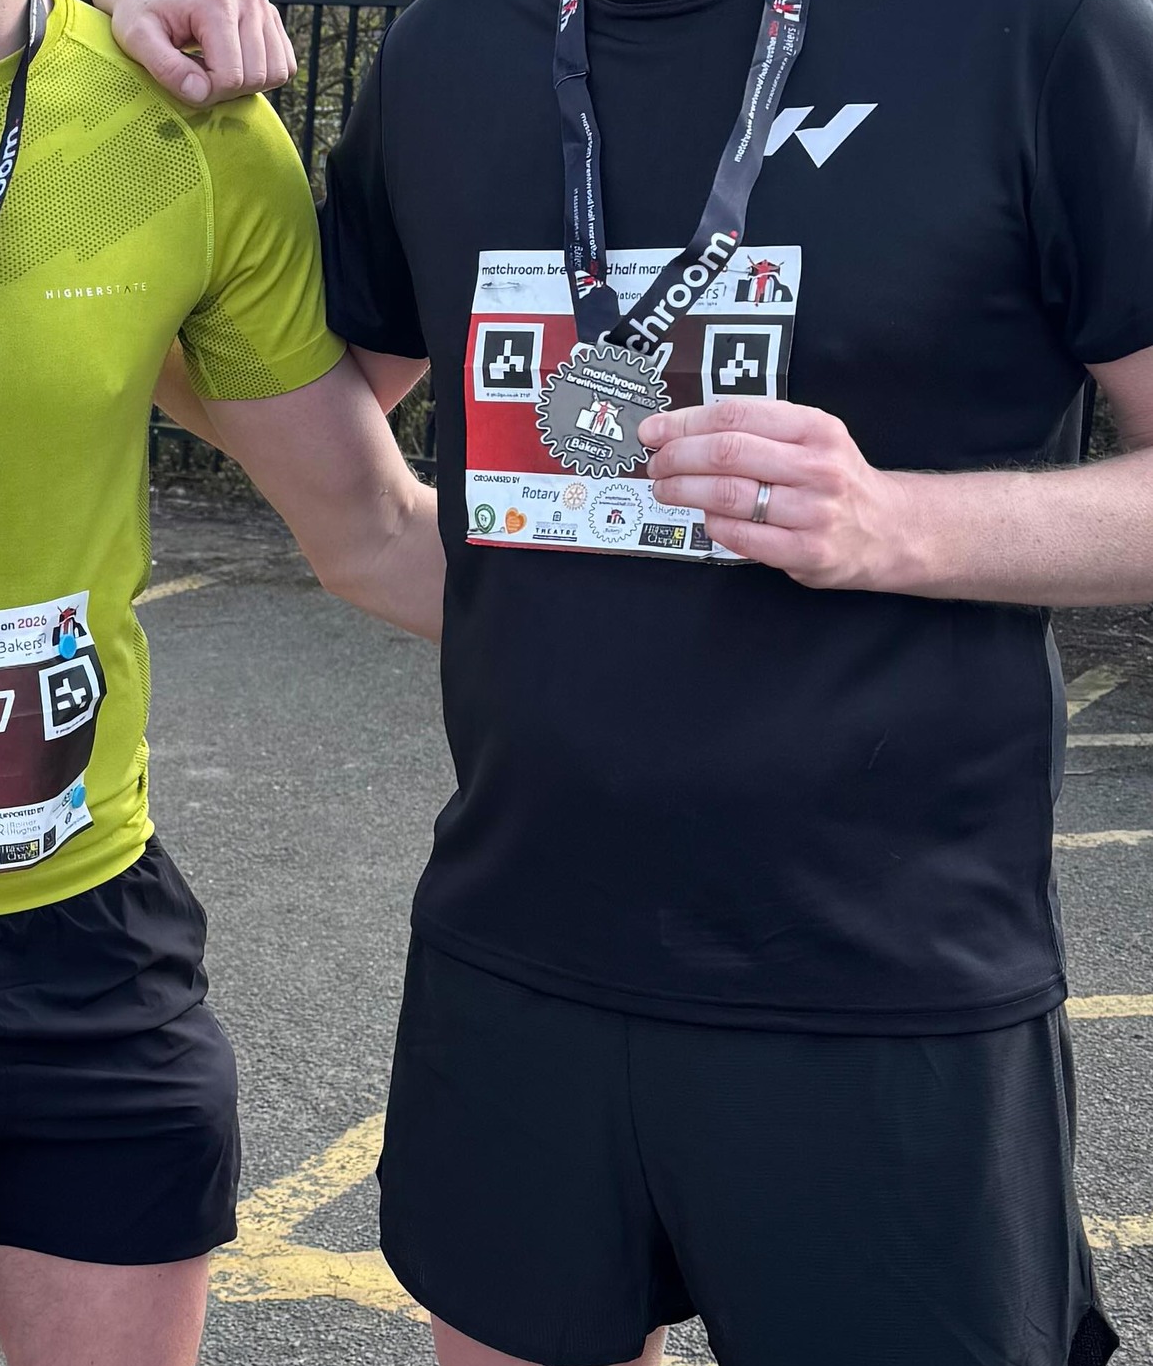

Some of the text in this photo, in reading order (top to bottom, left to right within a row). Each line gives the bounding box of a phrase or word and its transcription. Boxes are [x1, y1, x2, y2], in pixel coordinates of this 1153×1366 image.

[615, 262, 638, 275] half
[570, 437, 608, 458] Bakers
[521, 486, 561, 503] Rotary
[17, 615, 48, 630] 2026
